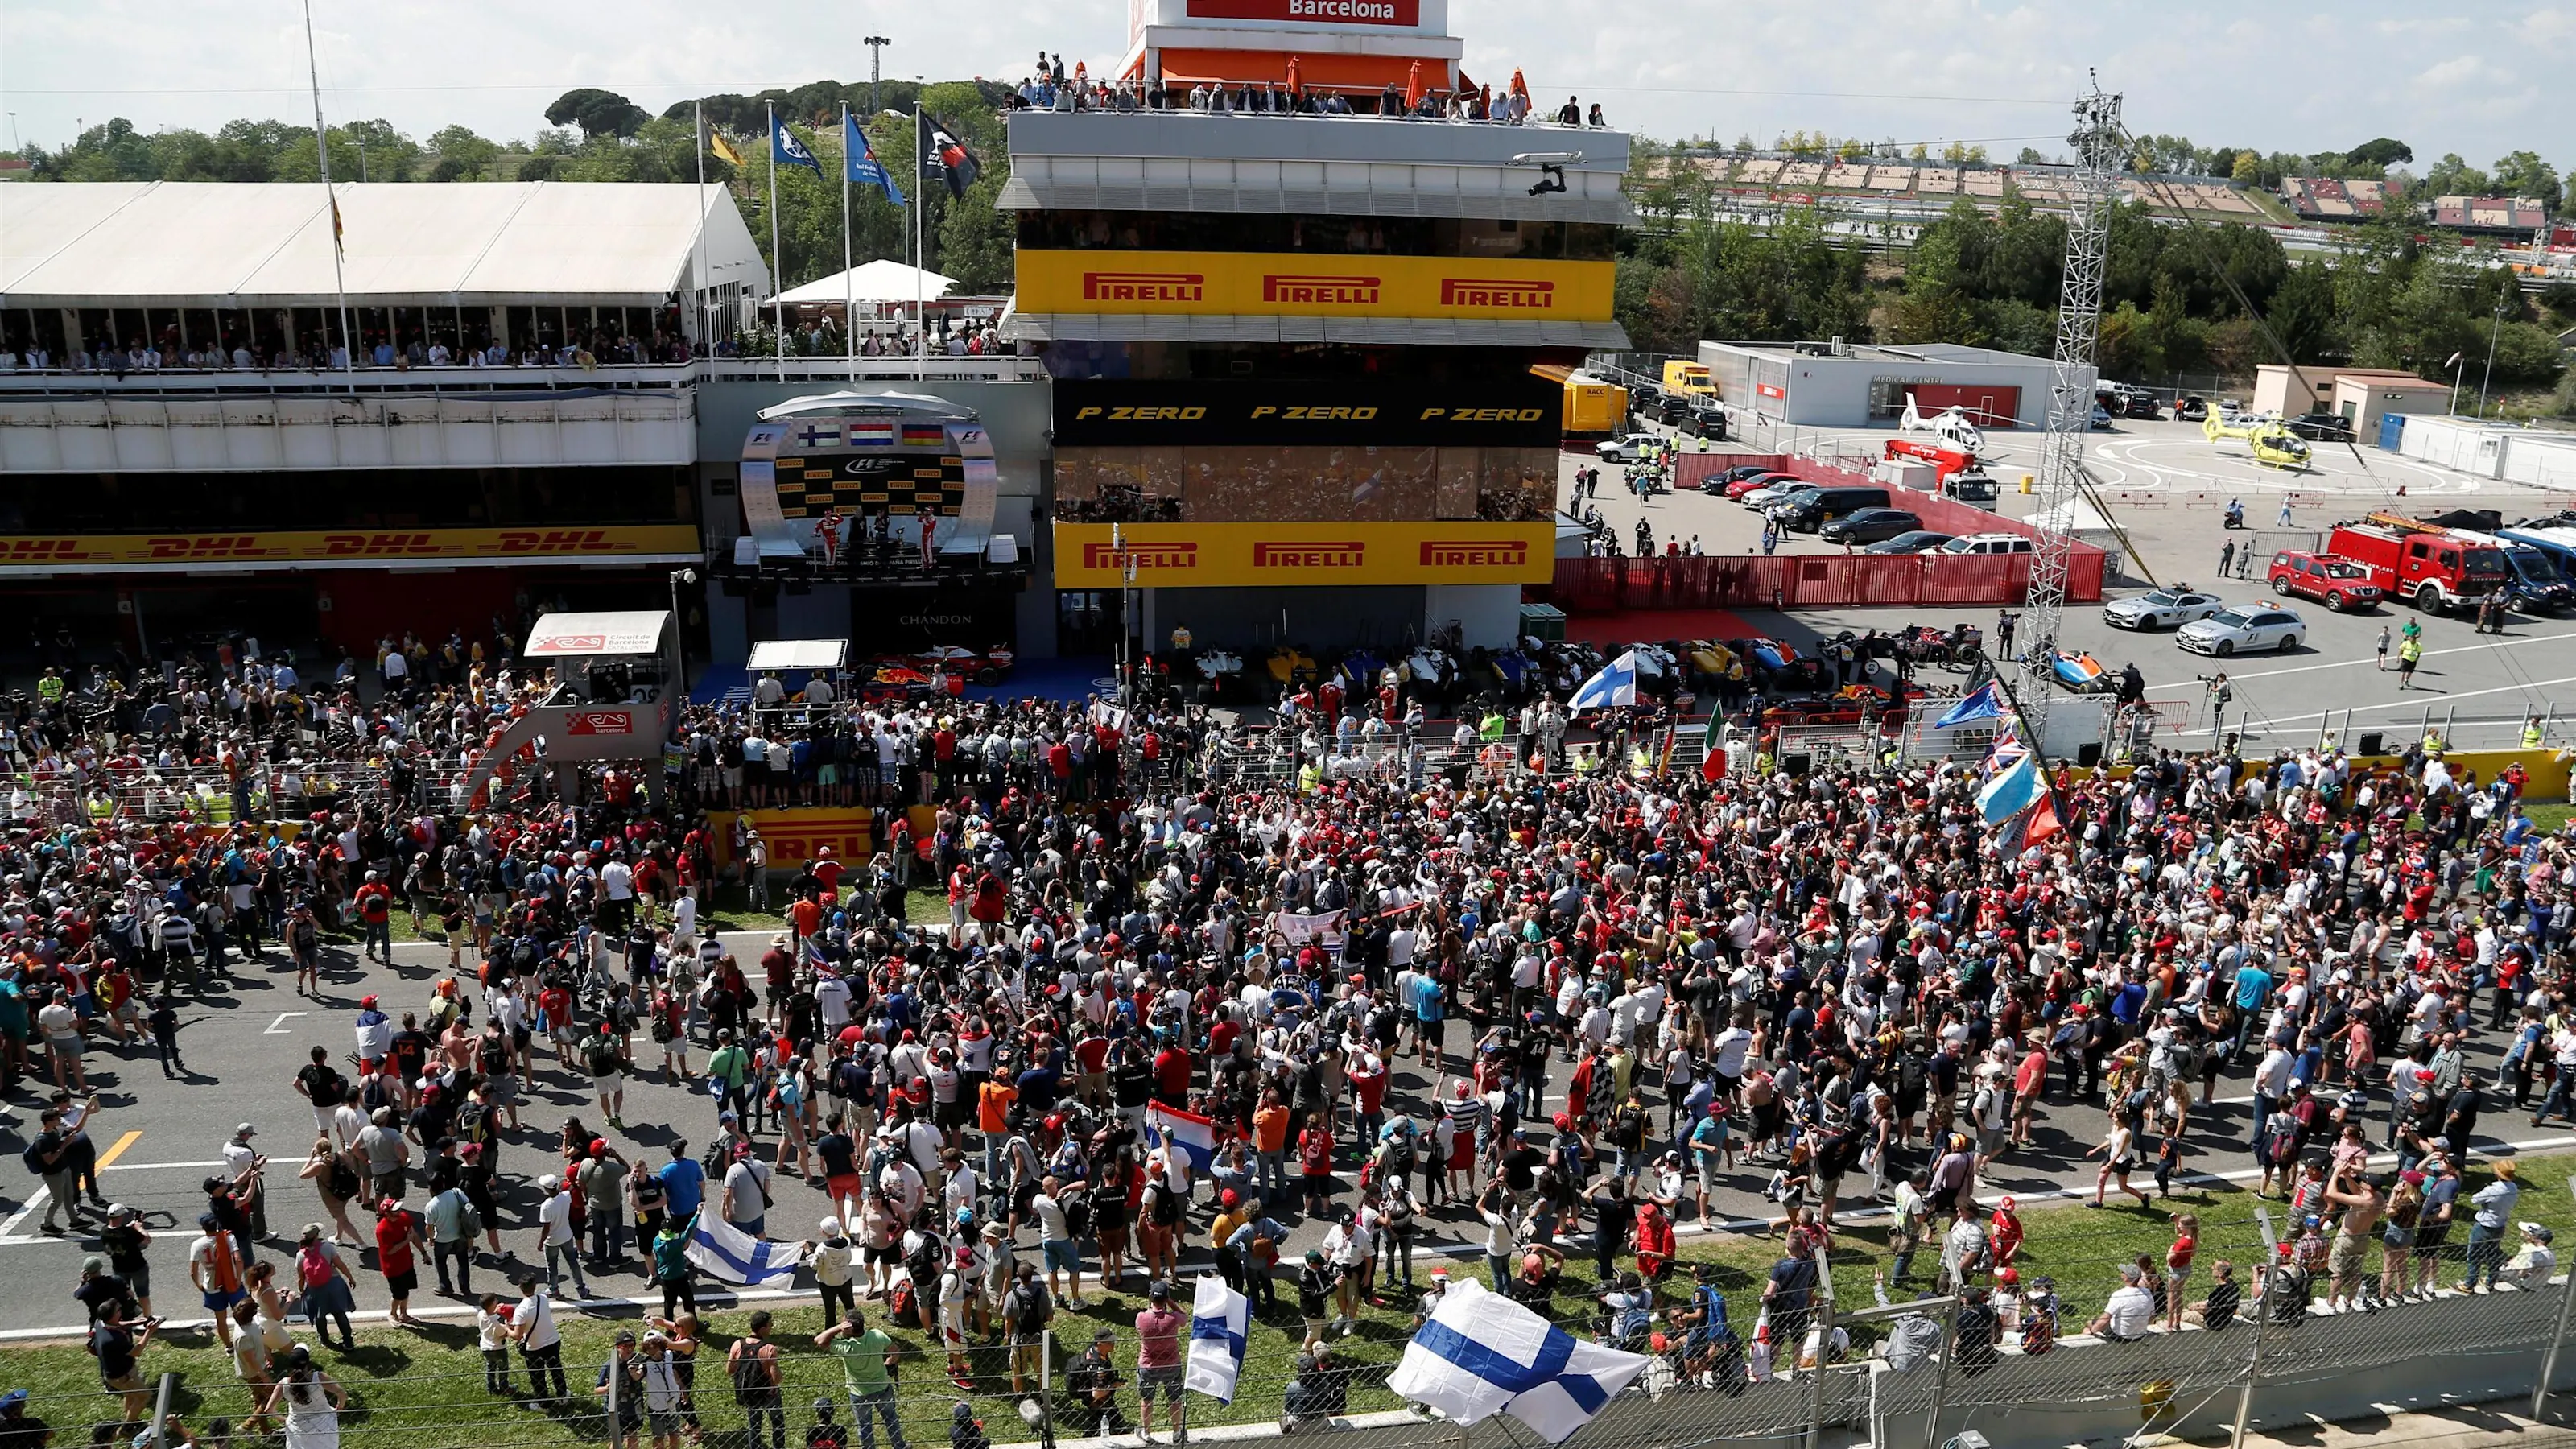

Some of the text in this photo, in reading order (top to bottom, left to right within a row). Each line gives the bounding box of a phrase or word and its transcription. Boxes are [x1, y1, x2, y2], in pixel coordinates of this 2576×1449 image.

[1290, 0, 1395, 19] Barcelona
[1084, 273, 1203, 300] PIRELLI
[1264, 275, 1381, 303] PIRELLI
[1441, 279, 1554, 307] PIRELLI
[1873, 375, 1909, 383] MEDICAL
[1077, 407, 1206, 419] P ZERO
[1251, 407, 1377, 419] P ZERO
[1421, 408, 1542, 421] P ZERO
[0, 541, 89, 559] HL
[147, 537, 267, 557] DHL
[324, 534, 442, 554] DHL
[497, 530, 614, 551] DHL
[1084, 542, 1197, 568] PIRELLI
[1254, 541, 1364, 567] PIRELLI
[1420, 540, 1527, 566] PIRELLI
[899, 615, 972, 625] CHANDON
[398, 1044, 415, 1056] 14
[1530, 1042, 1546, 1056] 44
